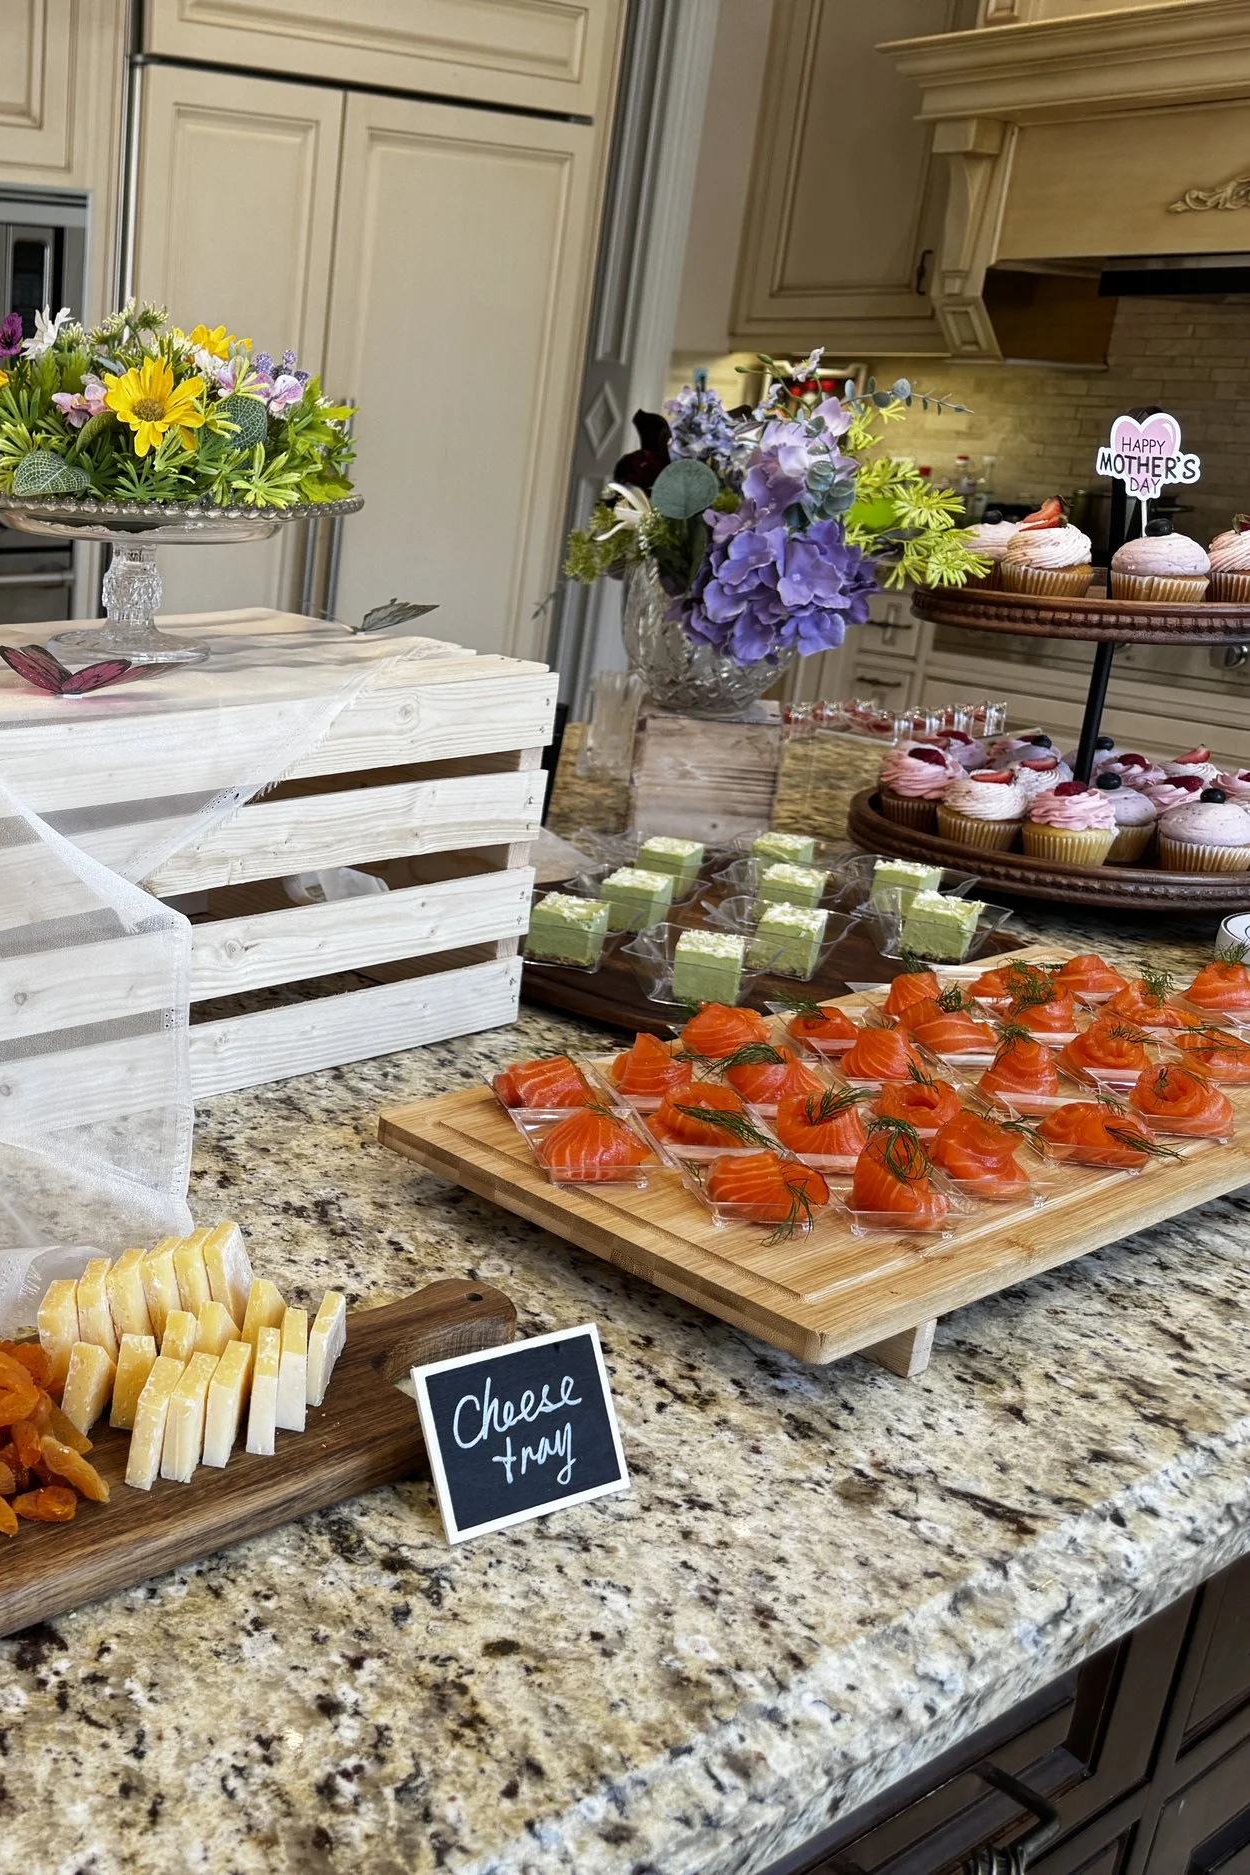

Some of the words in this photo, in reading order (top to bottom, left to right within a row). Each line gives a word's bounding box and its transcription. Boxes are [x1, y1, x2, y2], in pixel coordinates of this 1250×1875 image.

[1121, 436, 1166, 455] HAPPY
[1099, 452, 1196, 480] MOTHER'S
[1130, 477, 1161, 494] DAY
[453, 1375, 583, 1449] Cheese
[492, 1422, 577, 1485] tray
